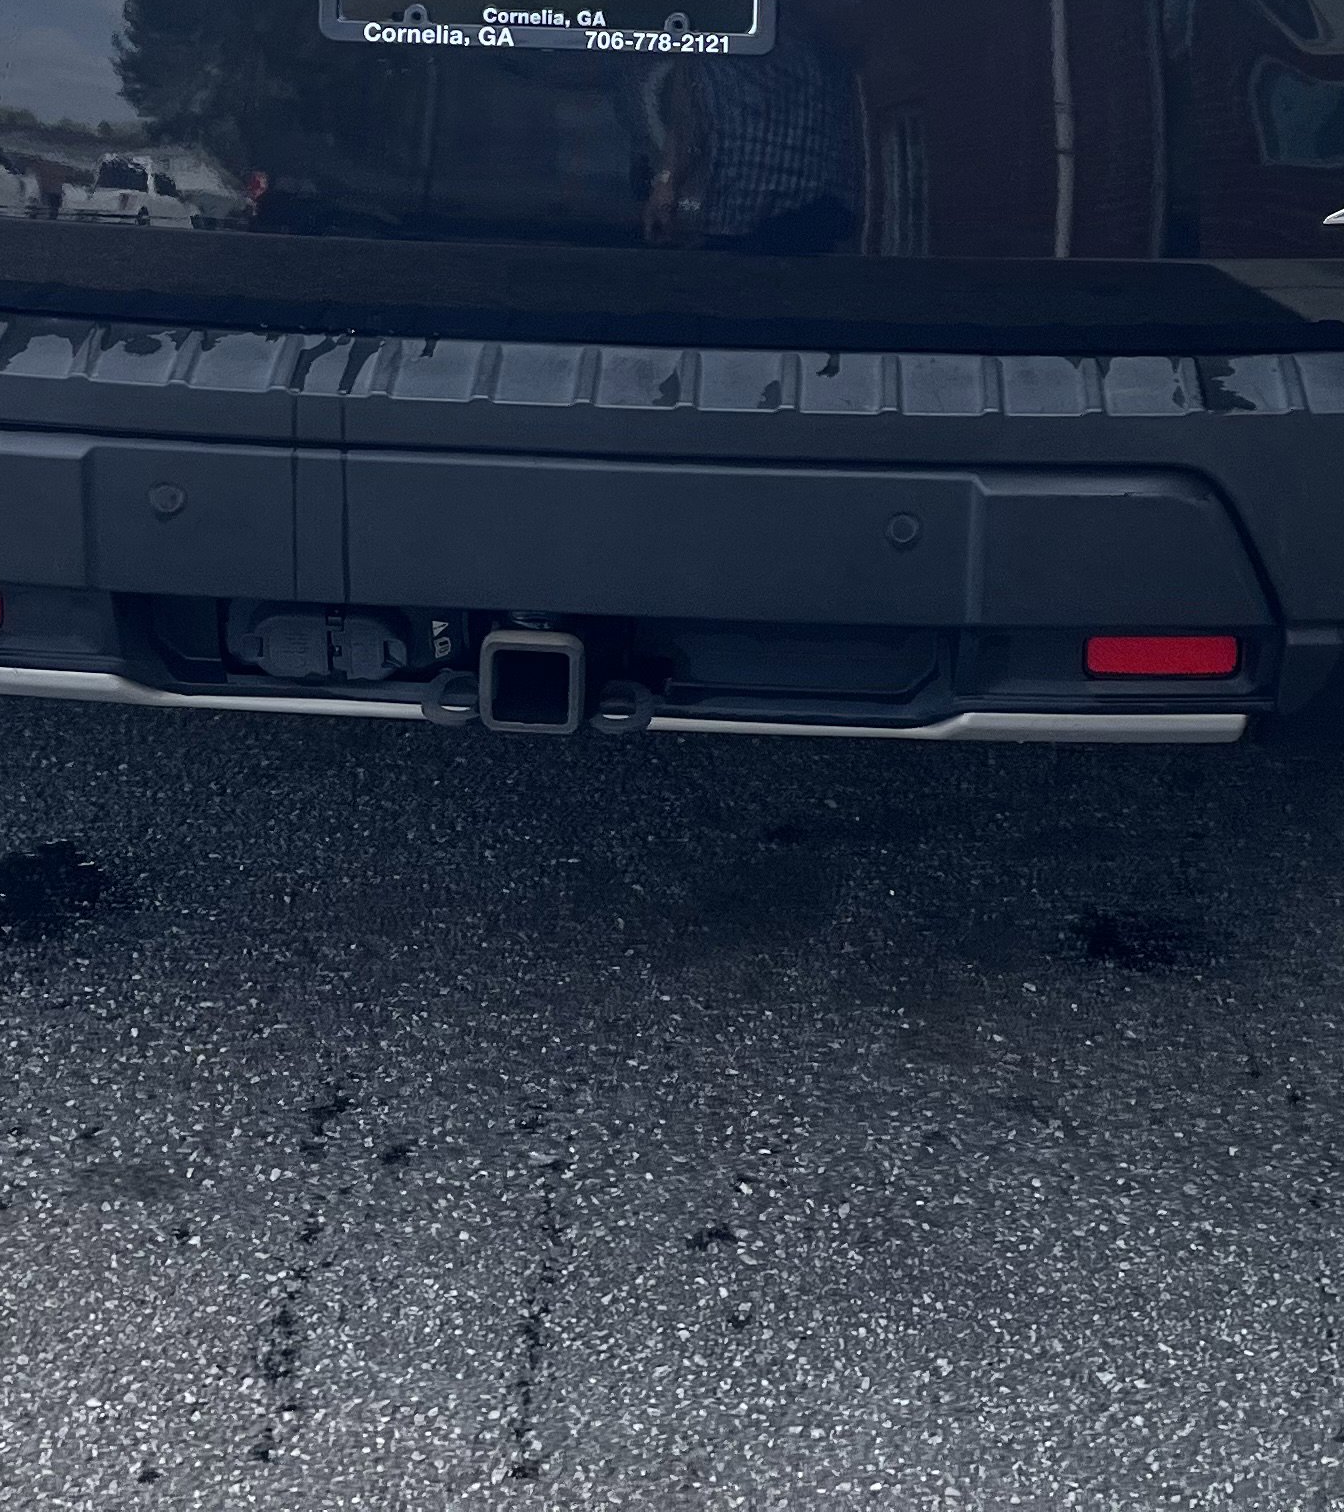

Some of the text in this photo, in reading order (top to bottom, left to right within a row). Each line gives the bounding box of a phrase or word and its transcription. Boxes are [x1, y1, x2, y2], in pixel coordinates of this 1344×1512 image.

[482, 6, 607, 29] Cornelia, GA
[363, 22, 515, 48] Cornelia, GA
[584, 30, 731, 54] 706-778-2121
